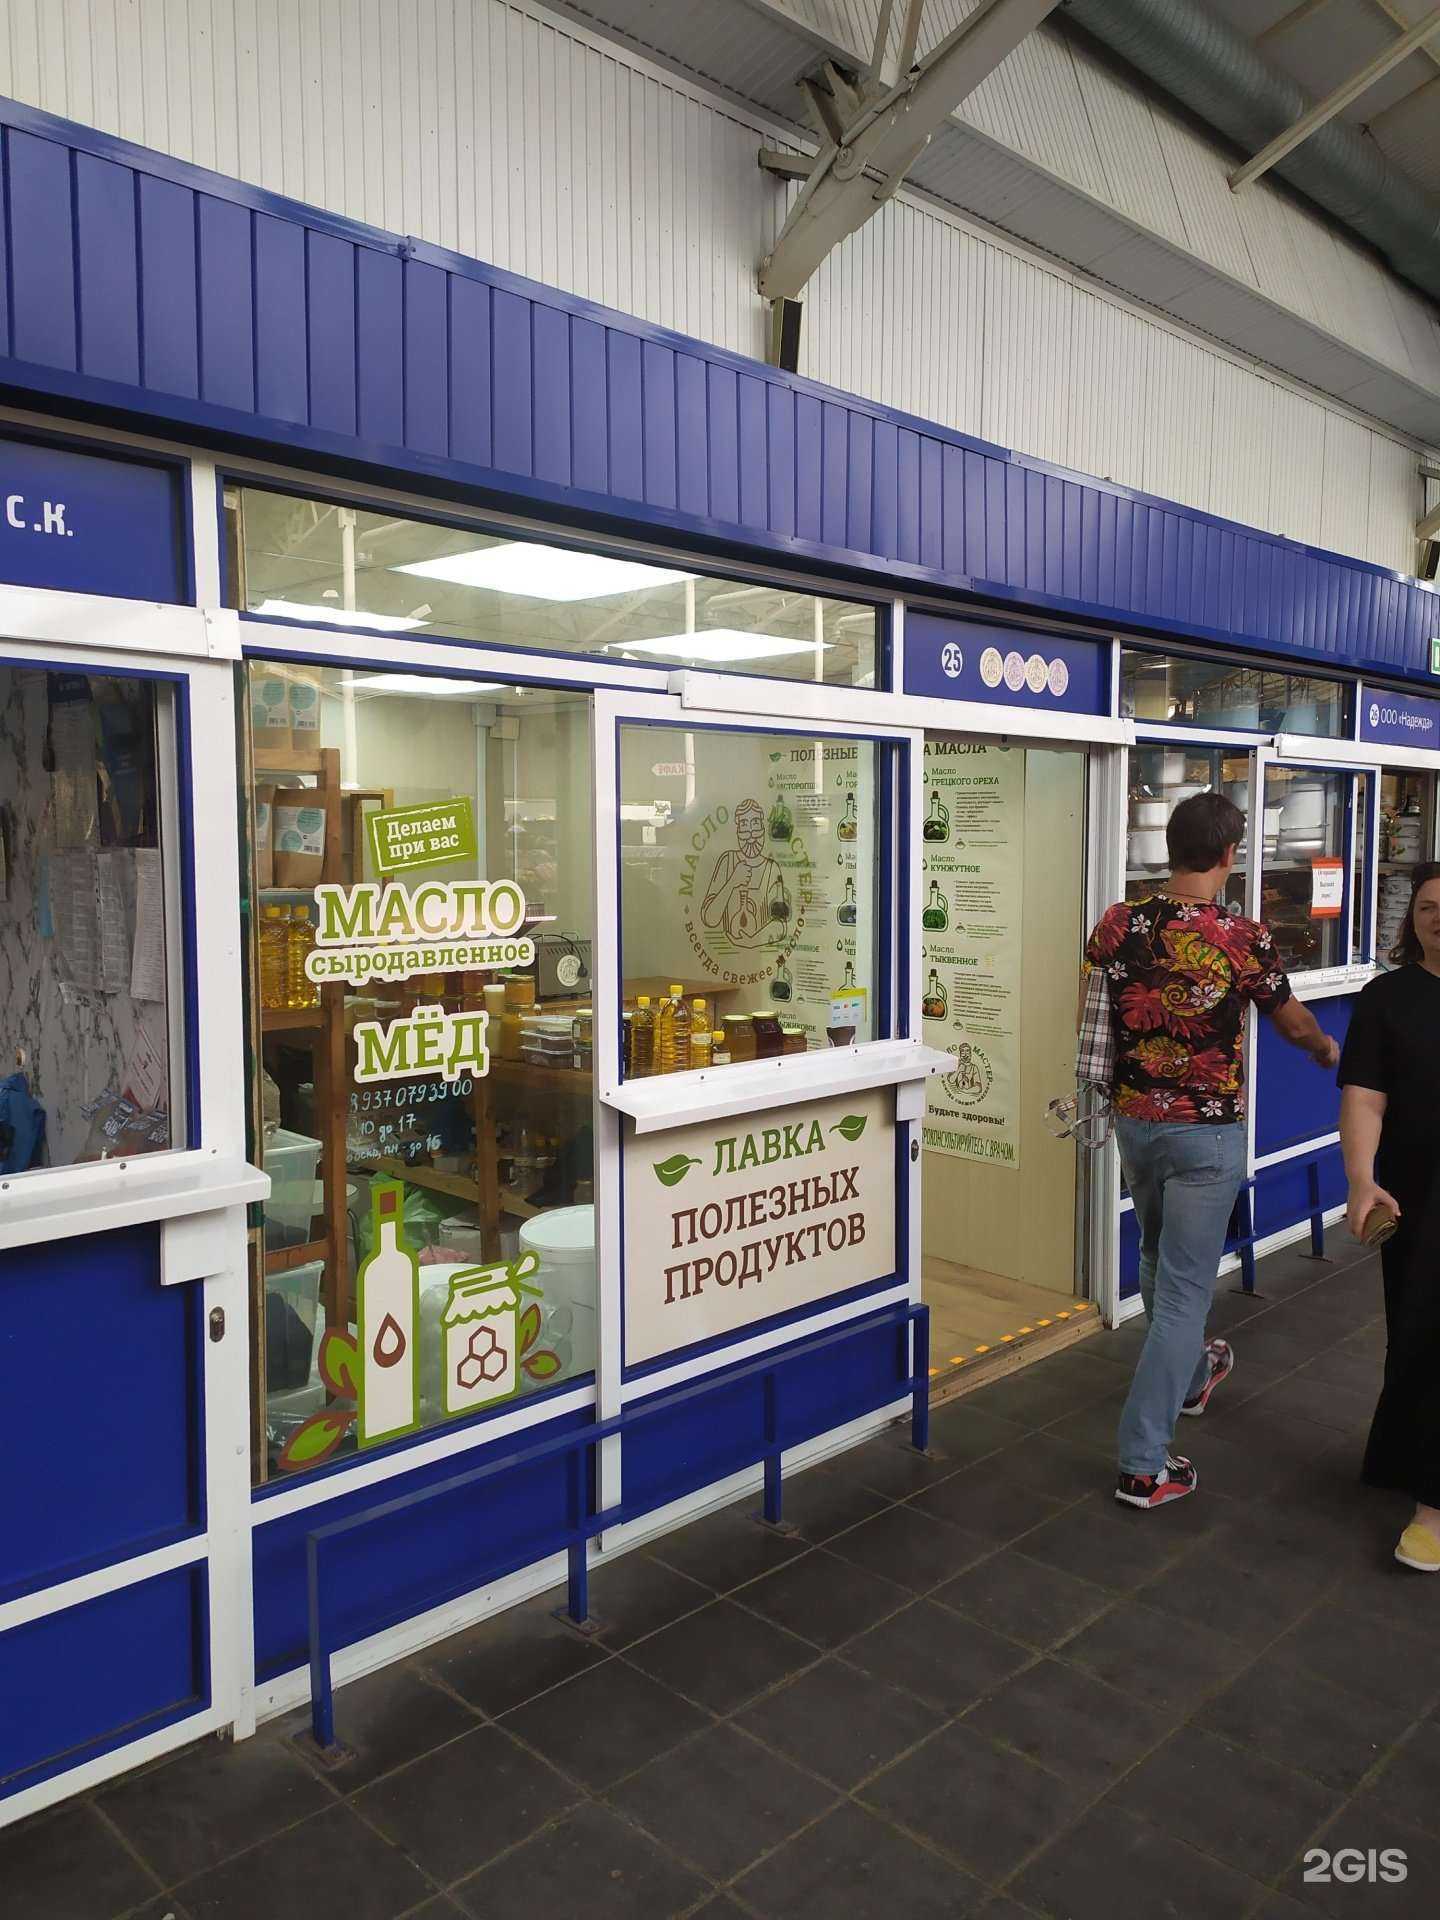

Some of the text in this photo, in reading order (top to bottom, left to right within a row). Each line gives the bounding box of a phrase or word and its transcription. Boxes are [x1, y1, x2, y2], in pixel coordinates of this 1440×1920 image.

[944, 648, 961, 672] 25
[1380, 707, 1398, 726] ООО
[1398, 711, 1434, 733] «Надежда»
[790, 746, 859, 762] ПОЛЗНЫЕ
[934, 743, 987, 756] МАСЛА
[931, 767, 957, 776] Масло
[931, 776, 1000, 787] ГРЕЦКОГО ОРЕХА
[386, 813, 457, 843] Делаем
[388, 832, 460, 860] при вас
[678, 805, 731, 897] МАСЛО
[930, 854, 956, 863] Масло
[930, 864, 981, 873] КУНЖУТНОЕ
[320, 884, 521, 940] МАСЛО
[311, 942, 531, 979] сыродавленное
[685, 920, 720, 976] всегда
[722, 963, 774, 985] свежее
[776, 917, 805, 968] масло
[929, 944, 955, 954] Масло
[929, 954, 979, 966] ТЫКВЕННОЕ
[359, 1010, 485, 1076] МЁД
[972, 1045, 993, 1083] МАСТЕР
[378, 1121, 393, 1143] до
[398, 1112, 417, 1134] 17
[928, 1104, 1006, 1126] Будьте здоровы!
[409, 1141, 422, 1159] до
[712, 1119, 826, 1177] ЛАВКА
[671, 1165, 860, 1250] ПОЛЕЗНЫХ
[663, 1211, 866, 1305] ПРОДУКТОВ
